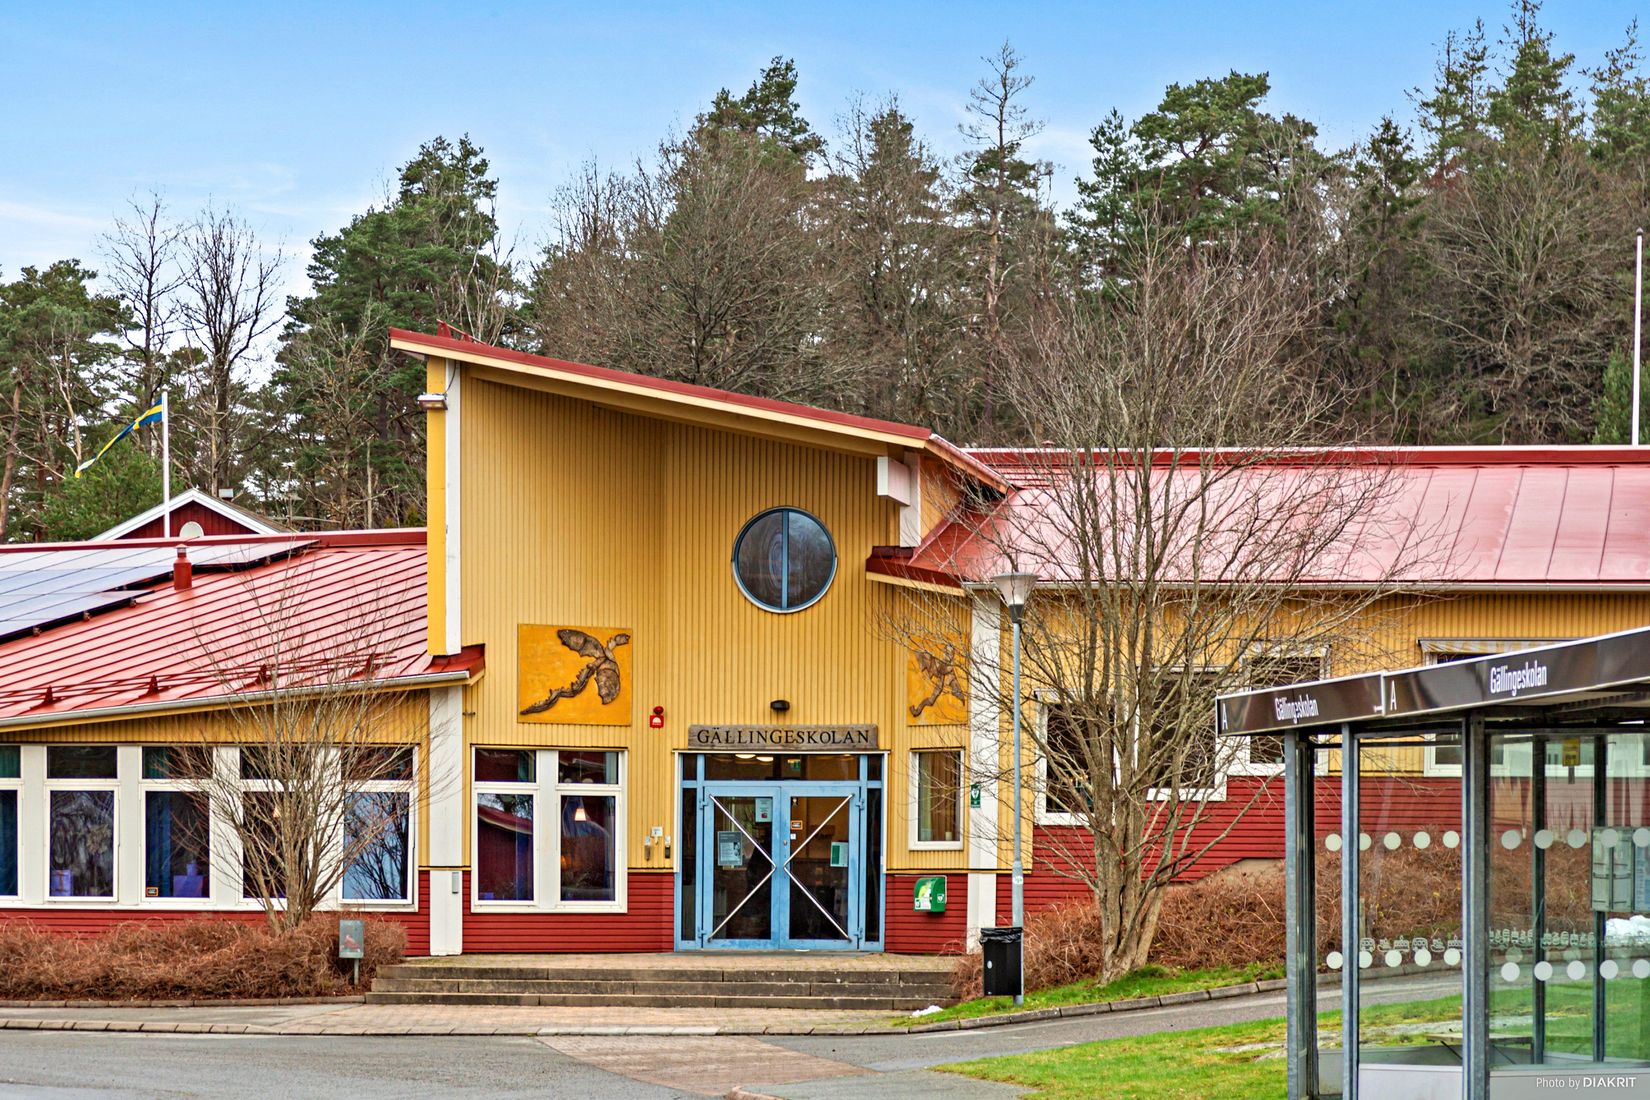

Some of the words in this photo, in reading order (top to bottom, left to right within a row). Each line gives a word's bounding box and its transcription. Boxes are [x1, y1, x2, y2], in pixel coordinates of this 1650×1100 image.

[1390, 680, 1398, 711] A
[1490, 659, 1548, 697] Gällingeskolan
[1222, 703, 1229, 730] A
[697, 727, 870, 745] GÄLLINGESKOLAN
